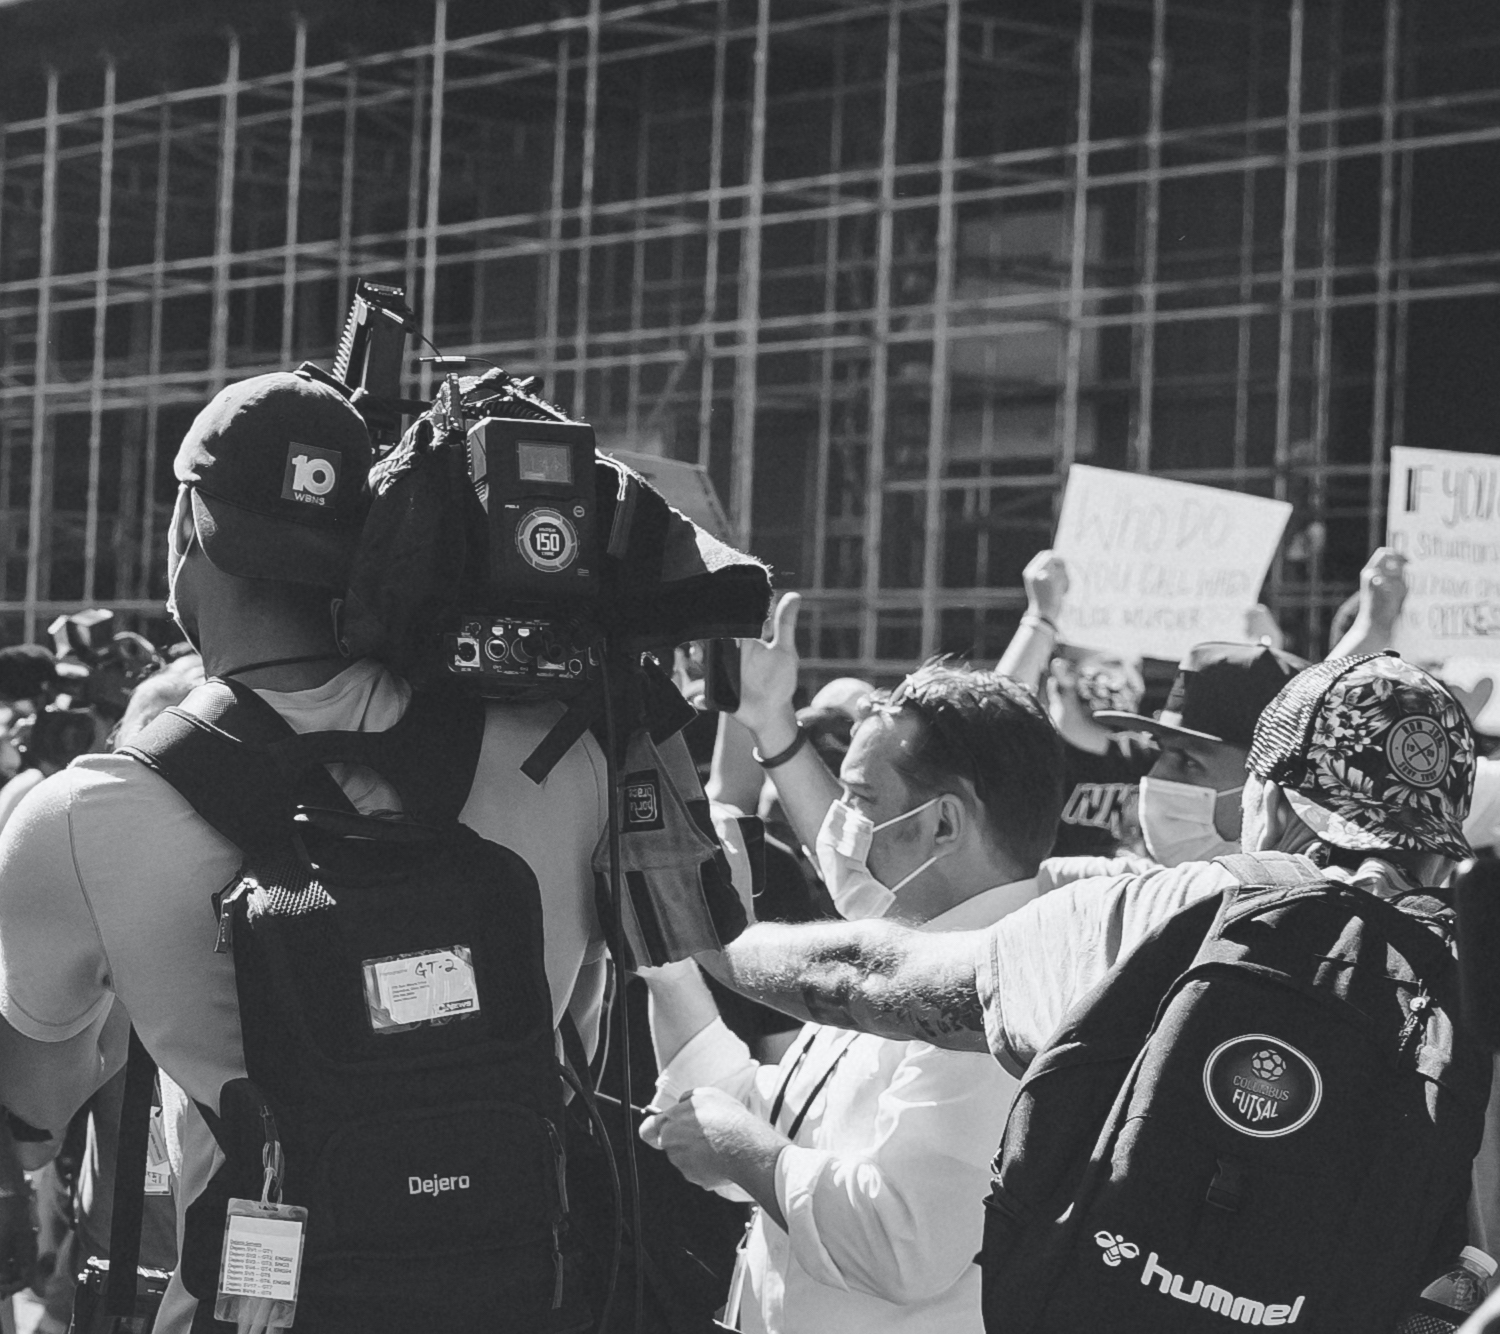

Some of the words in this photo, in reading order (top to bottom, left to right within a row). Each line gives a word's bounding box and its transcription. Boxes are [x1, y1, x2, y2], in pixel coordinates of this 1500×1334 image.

[291, 454, 336, 496] 10
[535, 532, 560, 552] 150
[1232, 1074, 1290, 1101] COLUMBUS
[1232, 1088, 1279, 1122] FUTSAL
[408, 1173, 470, 1197] Dejero
[1140, 1251, 1306, 1327] hummel
